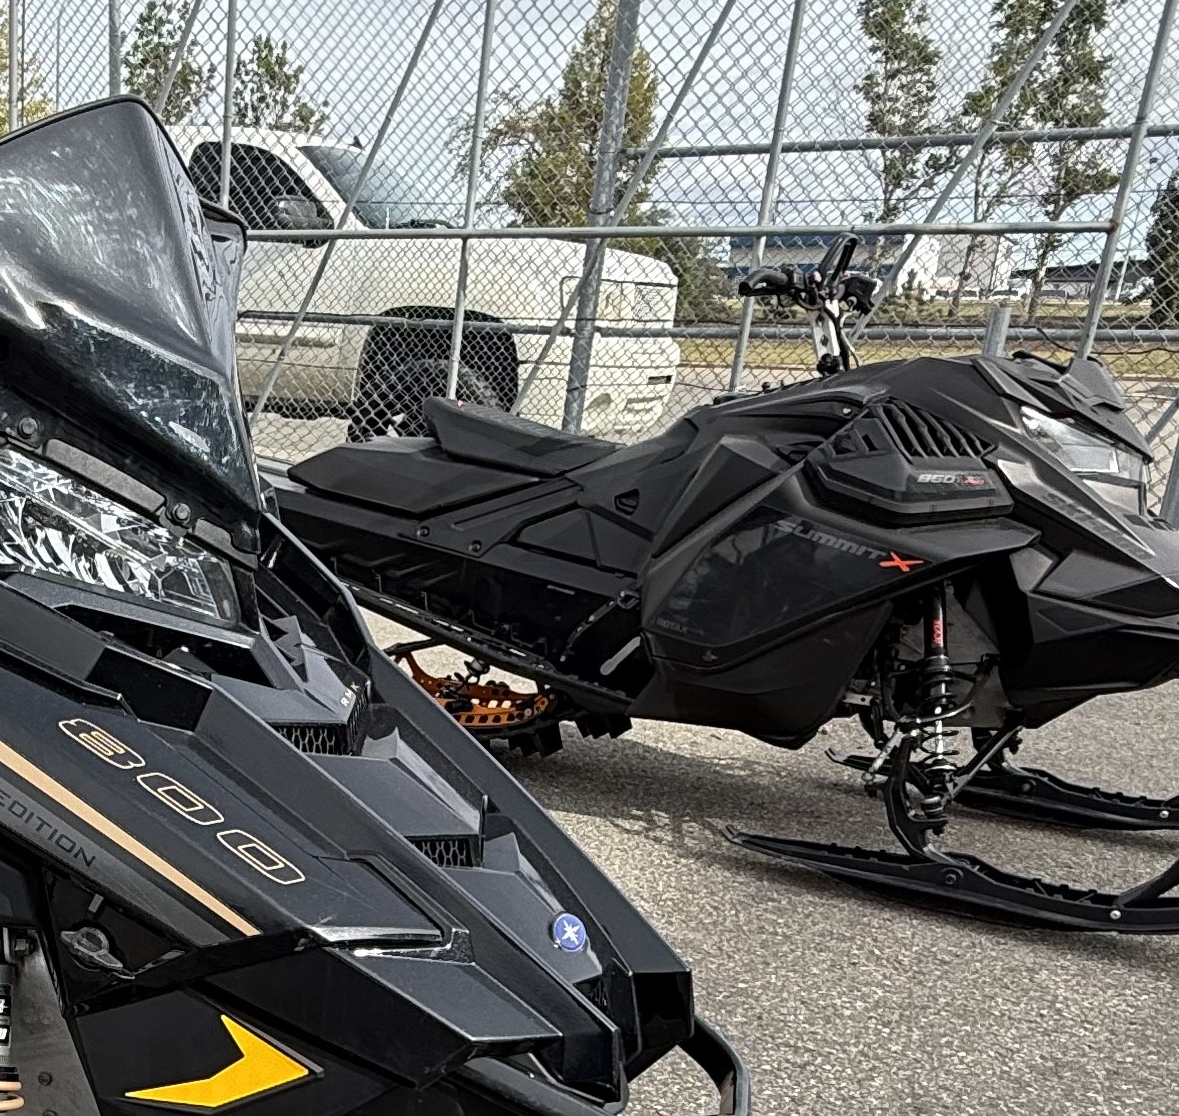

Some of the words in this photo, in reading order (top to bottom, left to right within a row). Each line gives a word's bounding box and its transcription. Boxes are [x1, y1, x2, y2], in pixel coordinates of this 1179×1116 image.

[917, 473, 957, 484] 850
[775, 519, 887, 560] SUMMIT
[878, 551, 925, 572] X
[340, 681, 360, 708] RMK
[58, 718, 306, 885] 800
